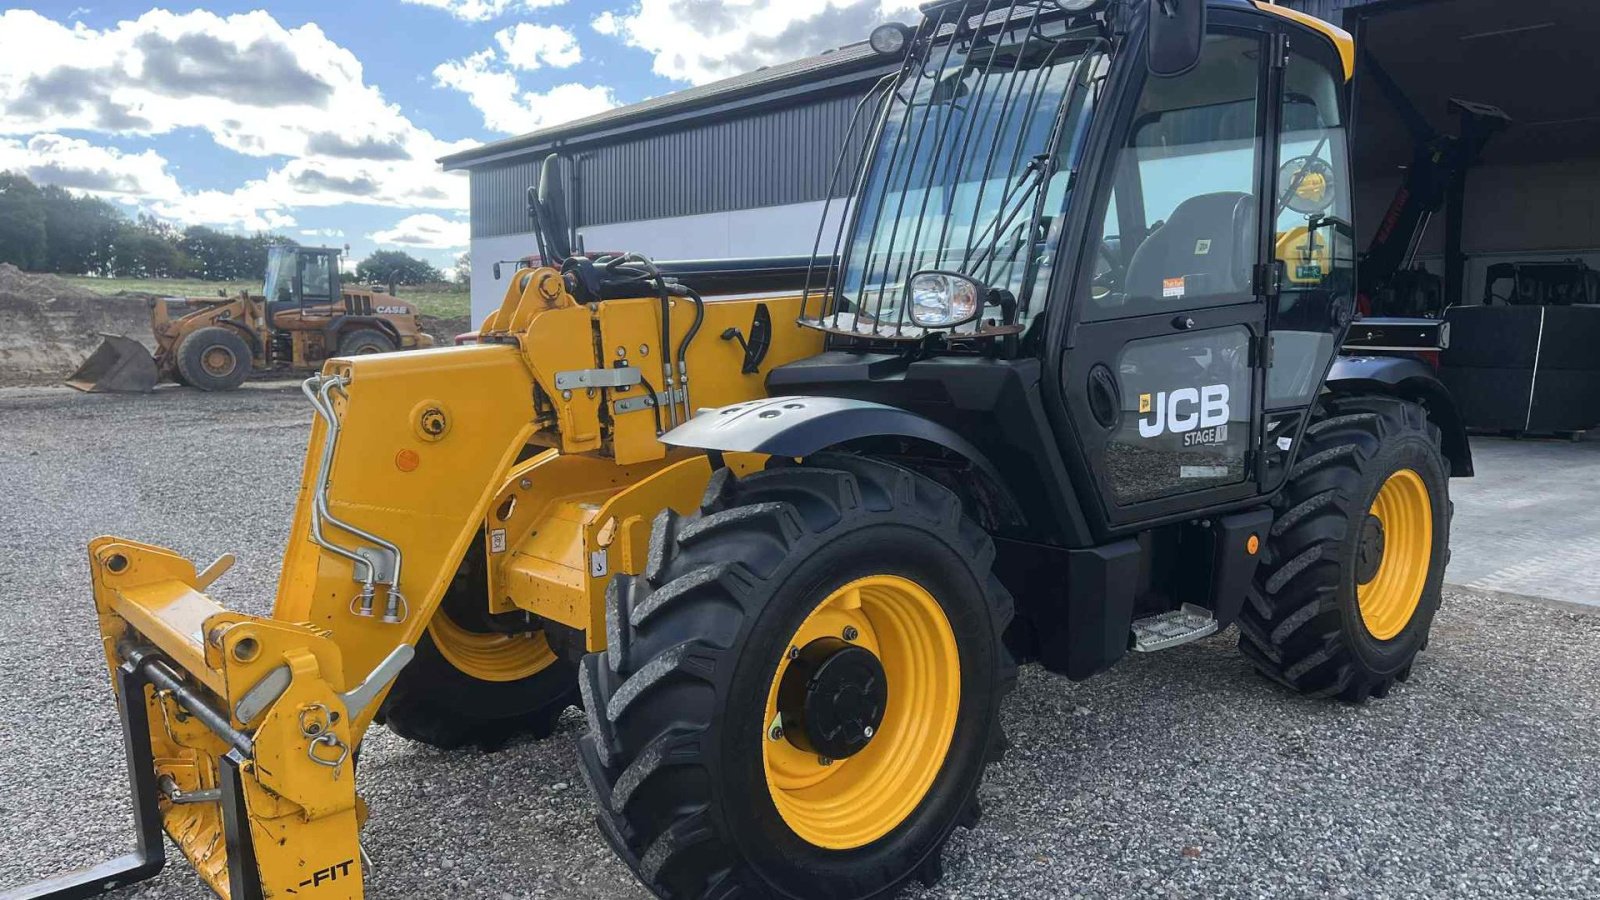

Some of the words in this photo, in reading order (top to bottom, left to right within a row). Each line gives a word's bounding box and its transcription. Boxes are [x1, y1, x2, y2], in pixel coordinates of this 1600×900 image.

[376, 306, 407, 314] CASE
[1138, 384, 1230, 438] JCB
[1184, 429, 1215, 446] STAGE
